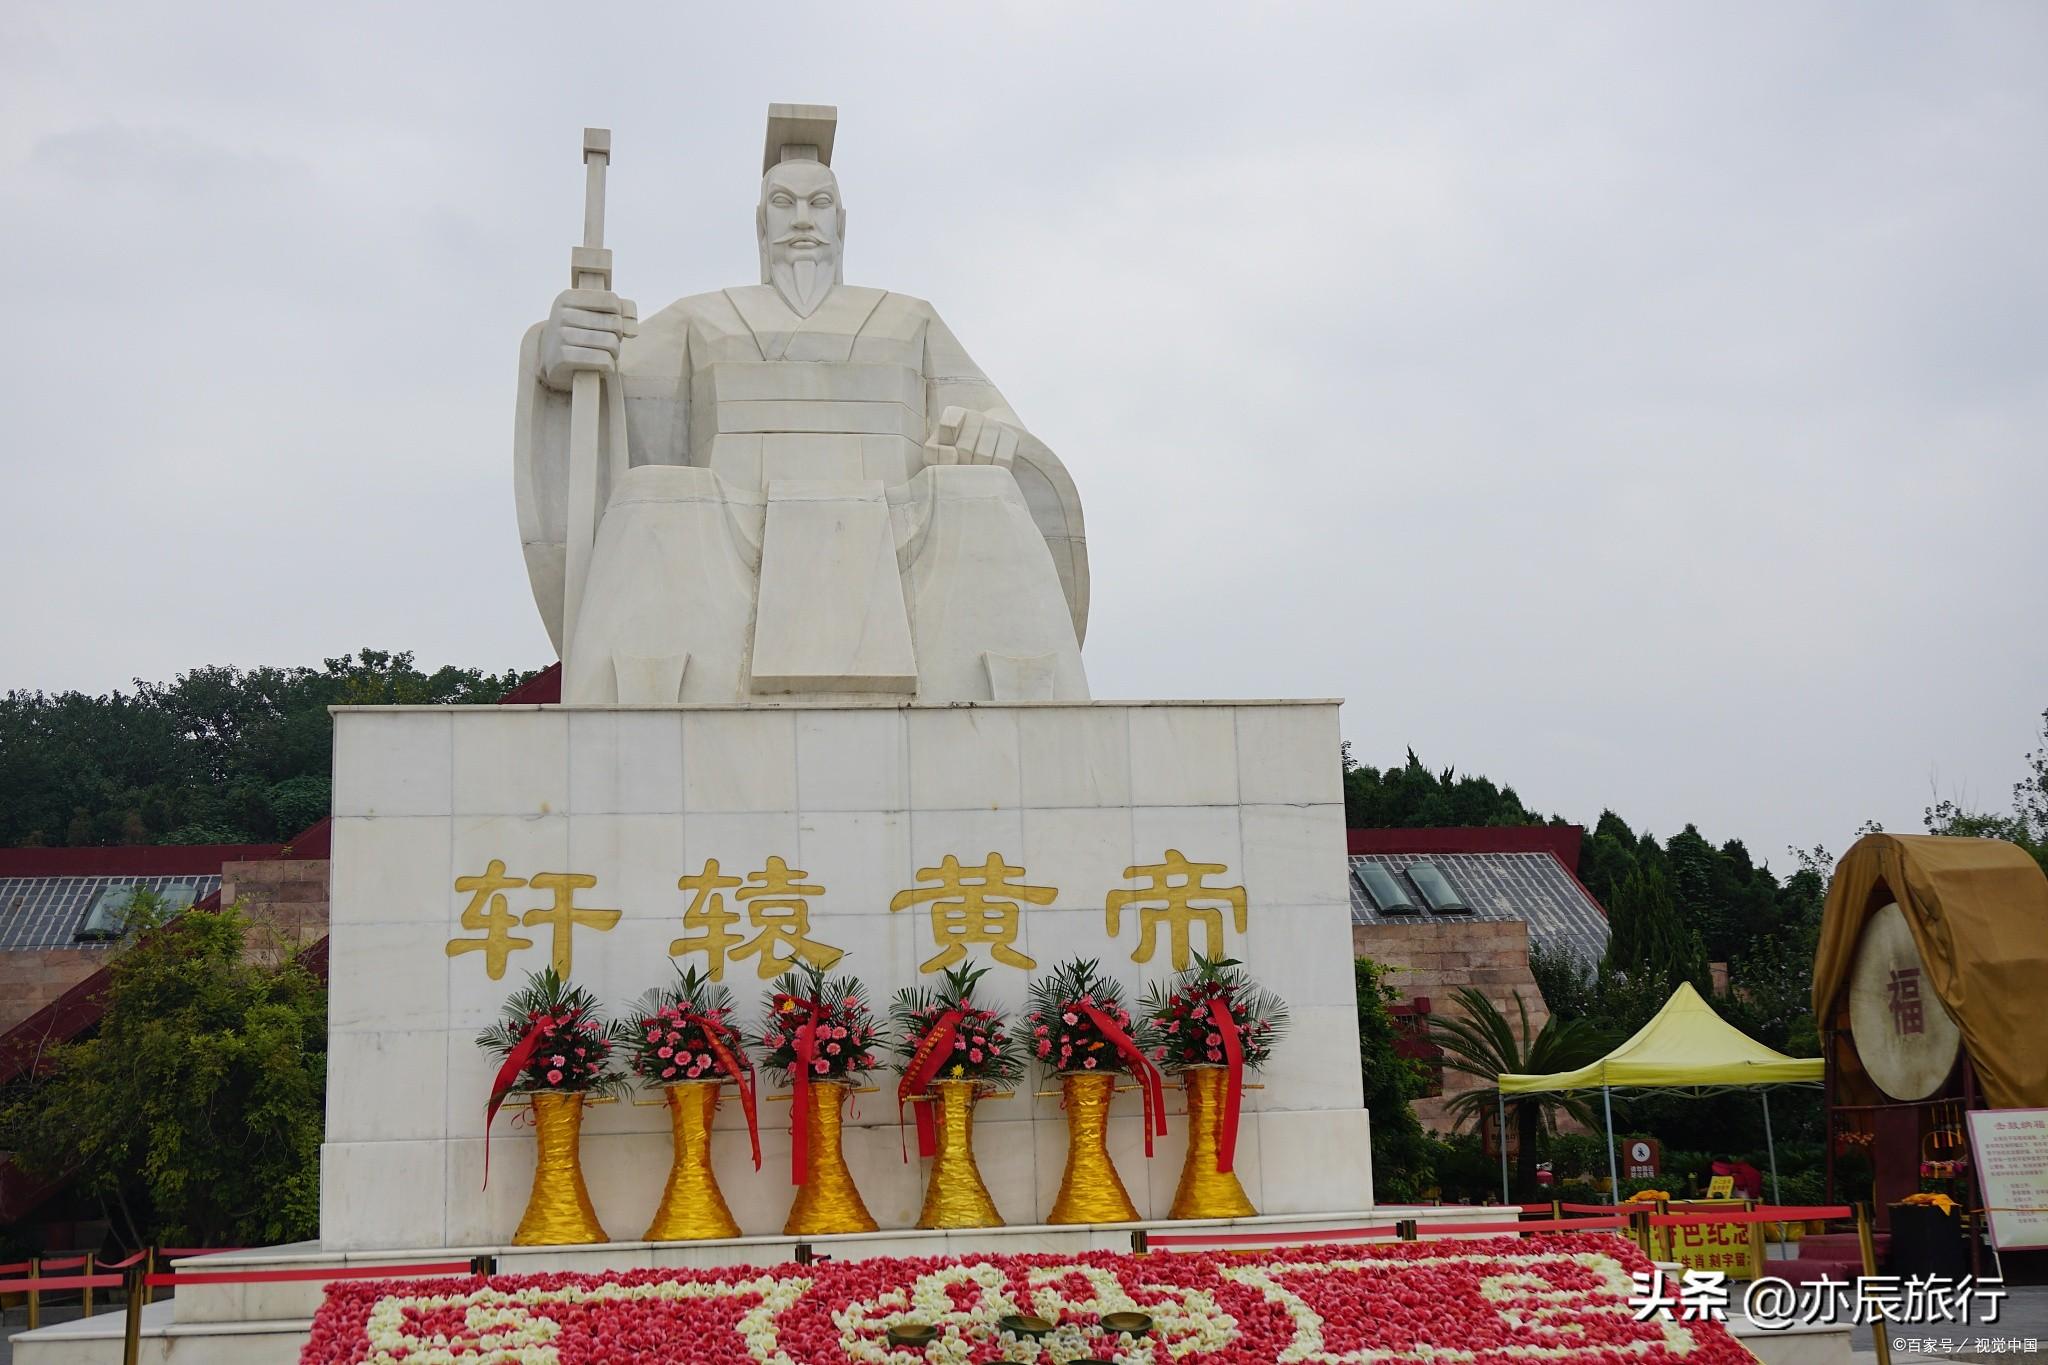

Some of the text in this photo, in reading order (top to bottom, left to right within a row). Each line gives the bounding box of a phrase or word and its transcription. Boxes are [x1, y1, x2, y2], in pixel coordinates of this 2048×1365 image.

[445, 848, 1247, 981] 轩辕黄帝
[1887, 967, 1924, 1035] 福
